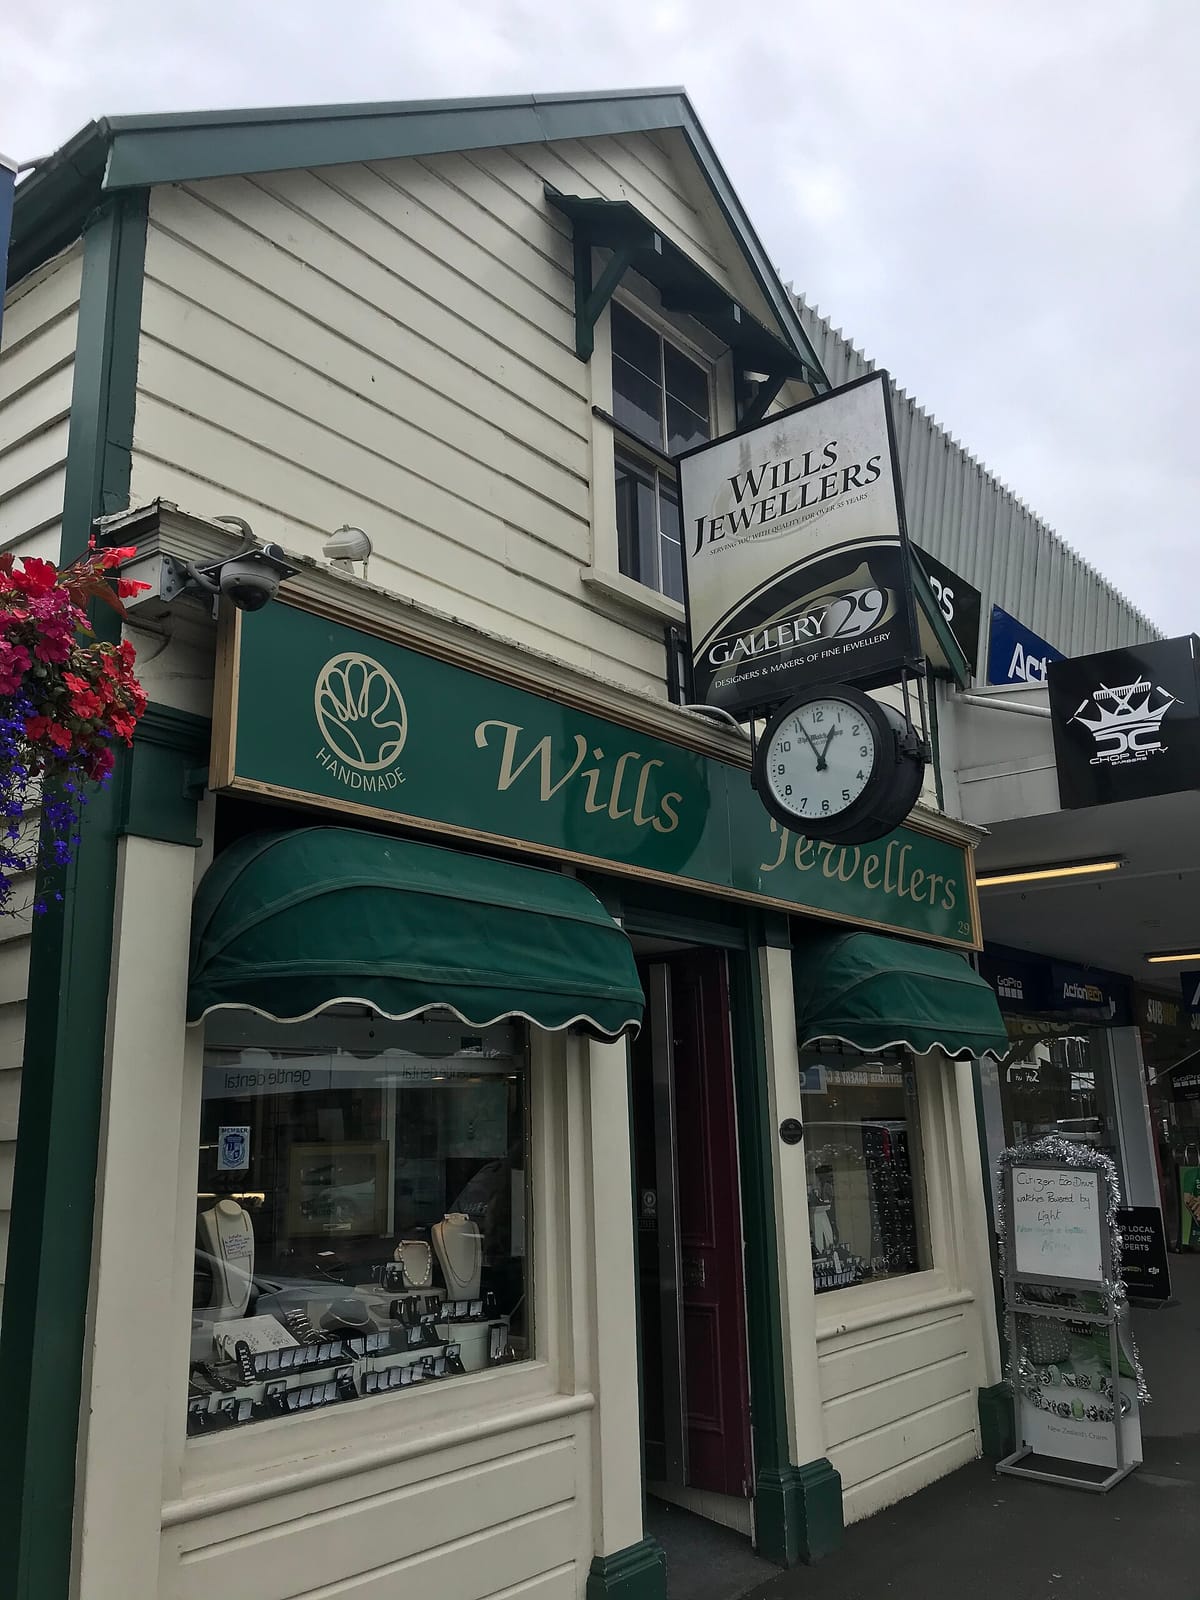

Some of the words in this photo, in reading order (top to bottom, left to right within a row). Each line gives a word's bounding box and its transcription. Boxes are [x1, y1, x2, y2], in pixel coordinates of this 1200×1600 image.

[727, 439, 838, 505] WILLS
[692, 454, 882, 558] JEWELLERS
[710, 543, 737, 555] SERVING
[737, 536, 751, 545] YOU
[751, 529, 770, 541] WITH
[770, 518, 800, 535] QUALITY
[801, 512, 816, 521] FOR
[816, 505, 835, 517] OVER
[845, 493, 868, 507] YEARS
[708, 611, 828, 665] GALLERY
[832, 586, 888, 638] 29
[714, 669, 760, 688] DESIGNERS
[761, 667, 768, 675] &
[770, 656, 804, 673] MAKERS
[806, 652, 819, 663] OF
[821, 647, 841, 659] FINE
[843, 631, 891, 654] JEWELLERY
[812, 711, 824, 723] 12
[837, 713, 841, 723] 1
[852, 724, 860, 736] 2
[779, 741, 791, 753] 10
[859, 746, 868, 757] 3
[1089, 752, 1130, 765] CHOP
[1135, 746, 1169, 757] CITY
[1111, 757, 1147, 766] BARBERS
[315, 747, 406, 793] HANDMADE
[777, 764, 785, 775] 9
[856, 770, 864, 780] 4
[474, 719, 684, 833] Wills
[785, 785, 792, 796] 8
[842, 790, 850, 801] 5
[800, 798, 808, 809] 7
[821, 800, 830, 811] 6
[760, 817, 956, 911] Jewellers
[957, 920, 970, 936] 29
[997, 975, 1022, 989] GoPro
[1016, 1172, 1055, 1192] Citizen
[1059, 1174, 1072, 1186] Eco
[1080, 1193, 1090, 1210] by
[1037, 1209, 1061, 1226] Light
[1128, 1225, 1156, 1234] LOCAL
[1124, 1234, 1152, 1243] DRONE
[1119, 1243, 1150, 1252] XPERTS
